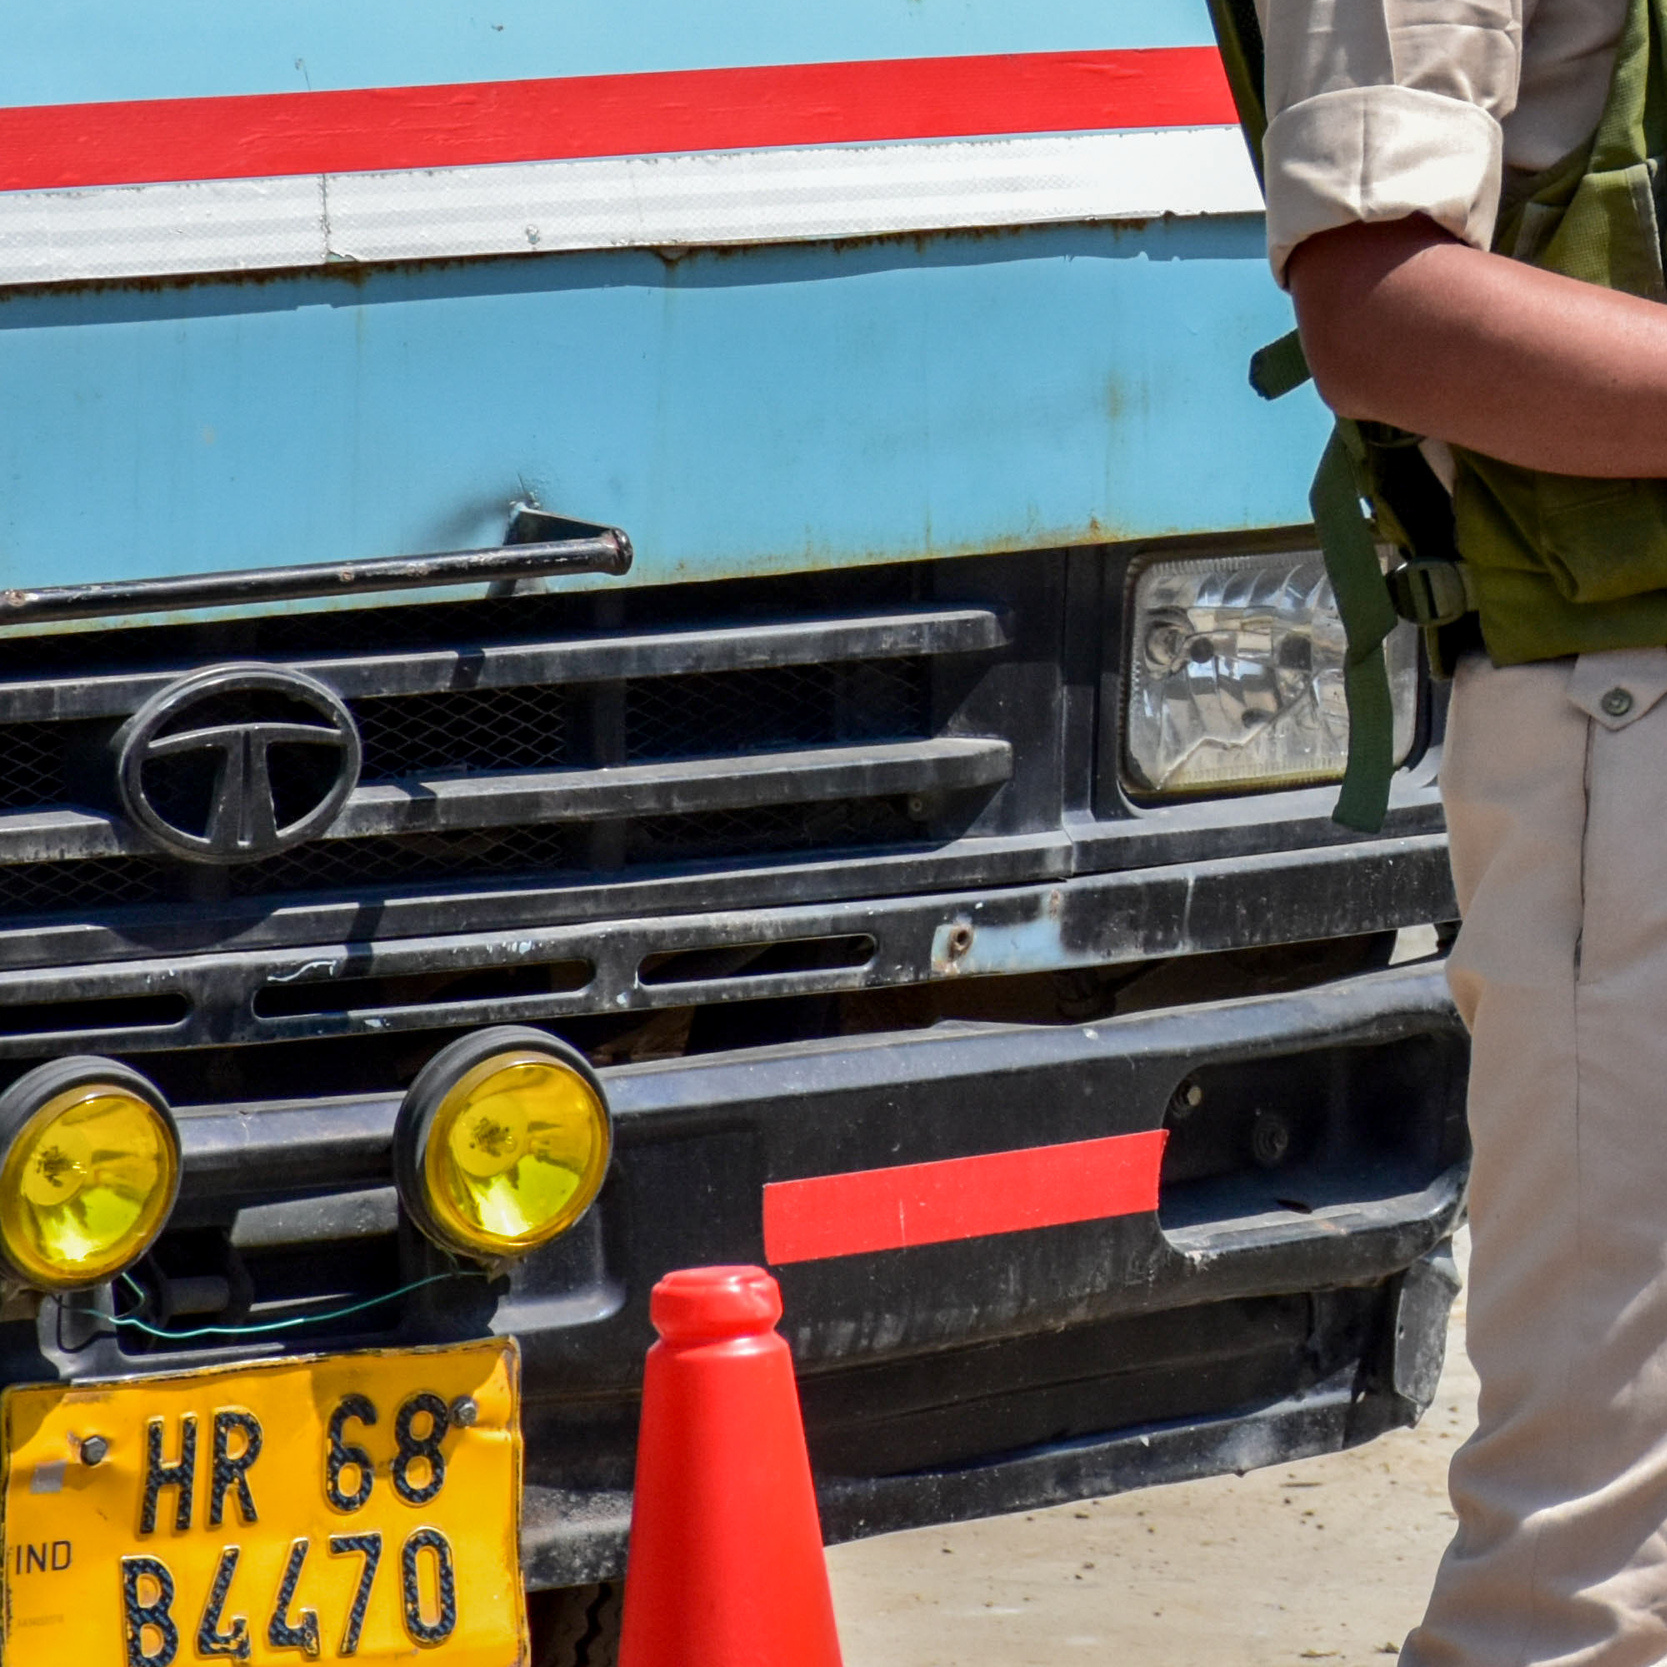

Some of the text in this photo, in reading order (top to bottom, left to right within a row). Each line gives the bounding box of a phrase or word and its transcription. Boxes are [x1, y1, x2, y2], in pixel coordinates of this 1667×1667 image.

[138, 1390, 450, 1536] HR 68
[15, 1540, 72, 1574] IND
[121, 1526, 457, 1667] B4470
